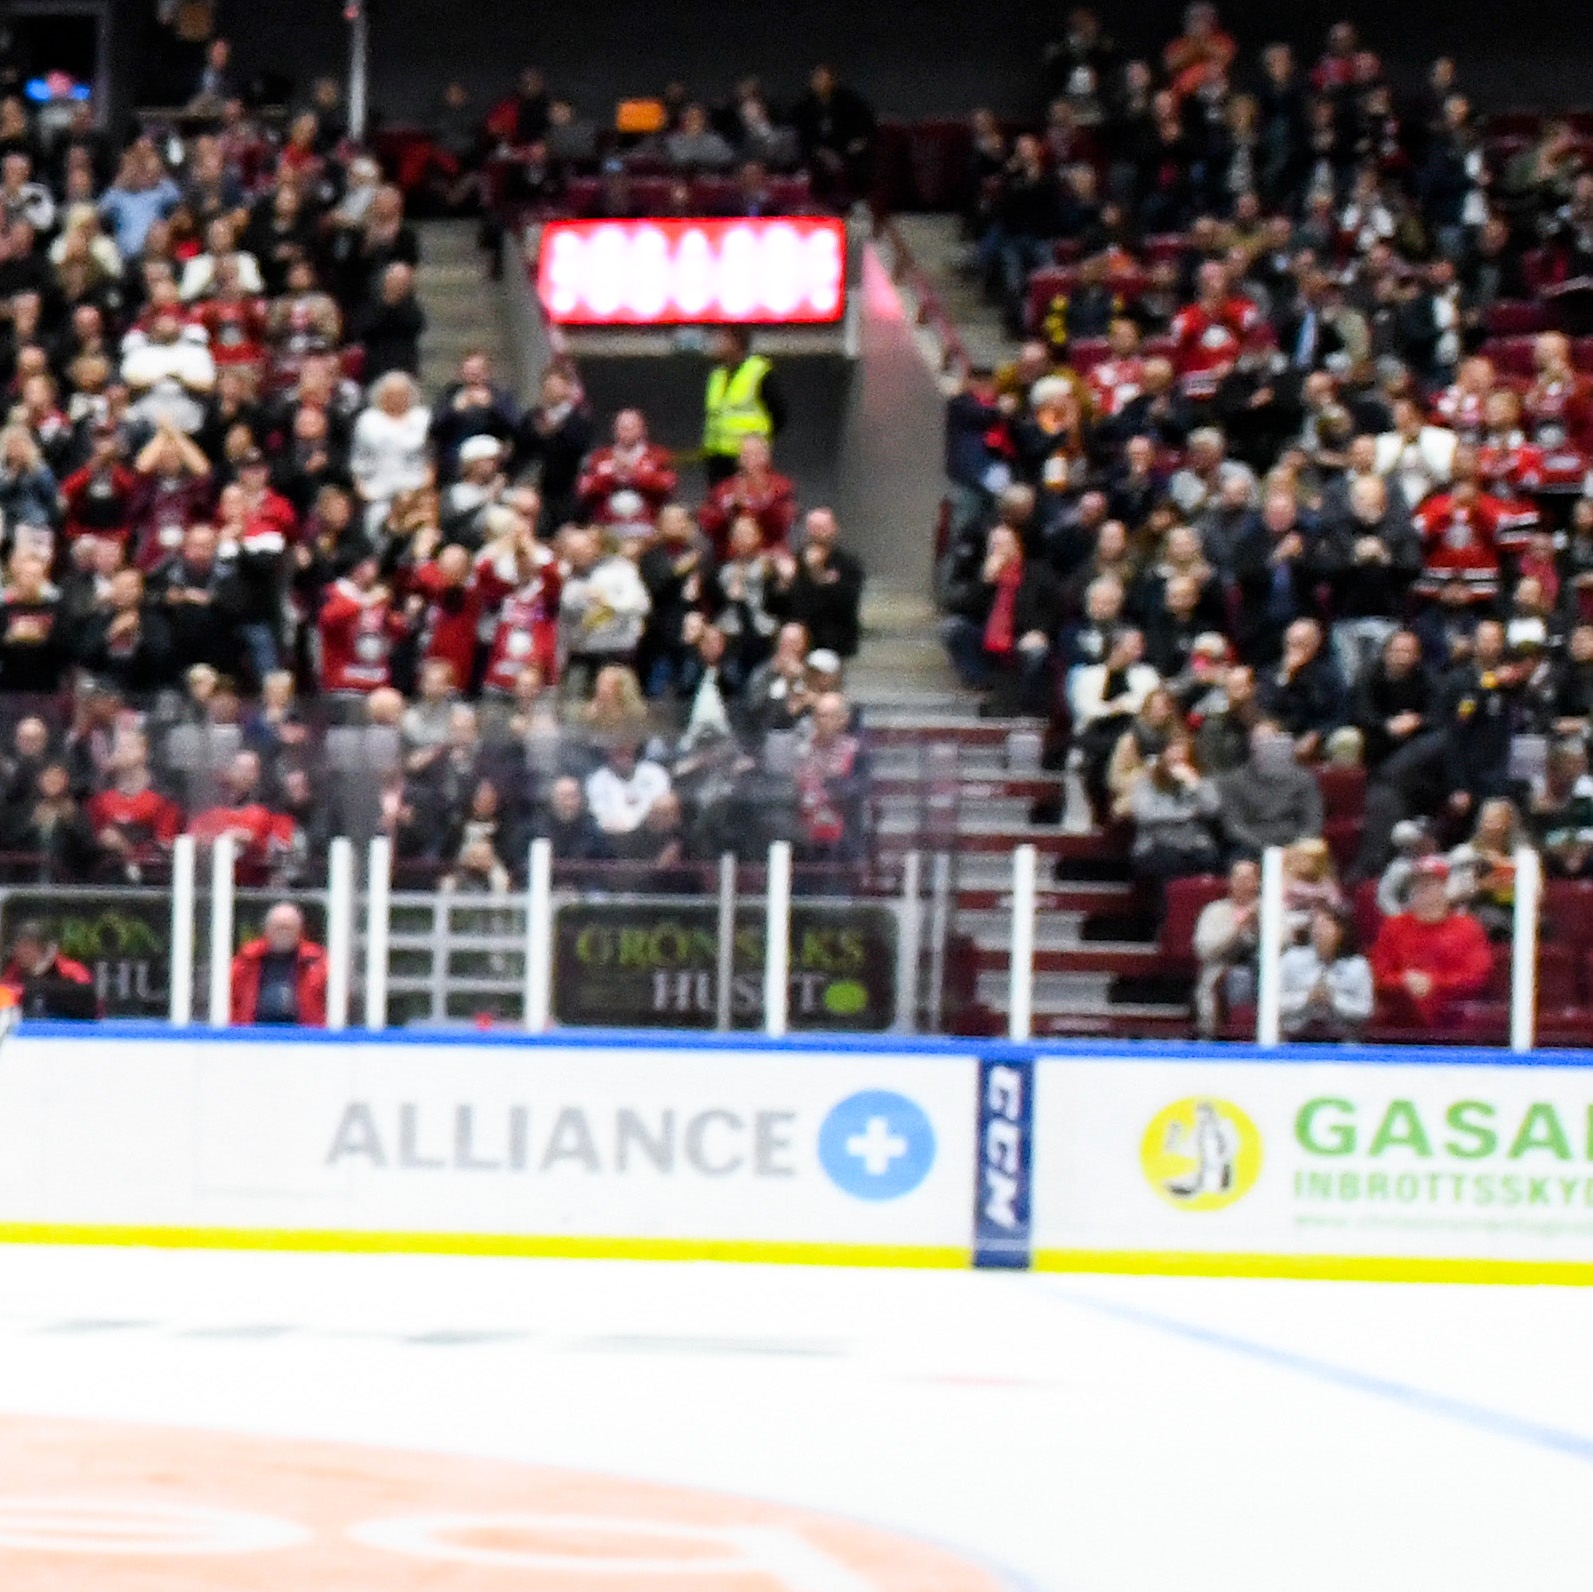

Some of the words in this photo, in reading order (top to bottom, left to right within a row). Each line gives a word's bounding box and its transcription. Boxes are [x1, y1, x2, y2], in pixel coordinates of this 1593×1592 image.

[652, 968, 828, 1014] HUST
[325, 1100, 799, 1178] ALLIANCE
[983, 1064, 1024, 1231] CCM
[1294, 1096, 1593, 1162] GASA
